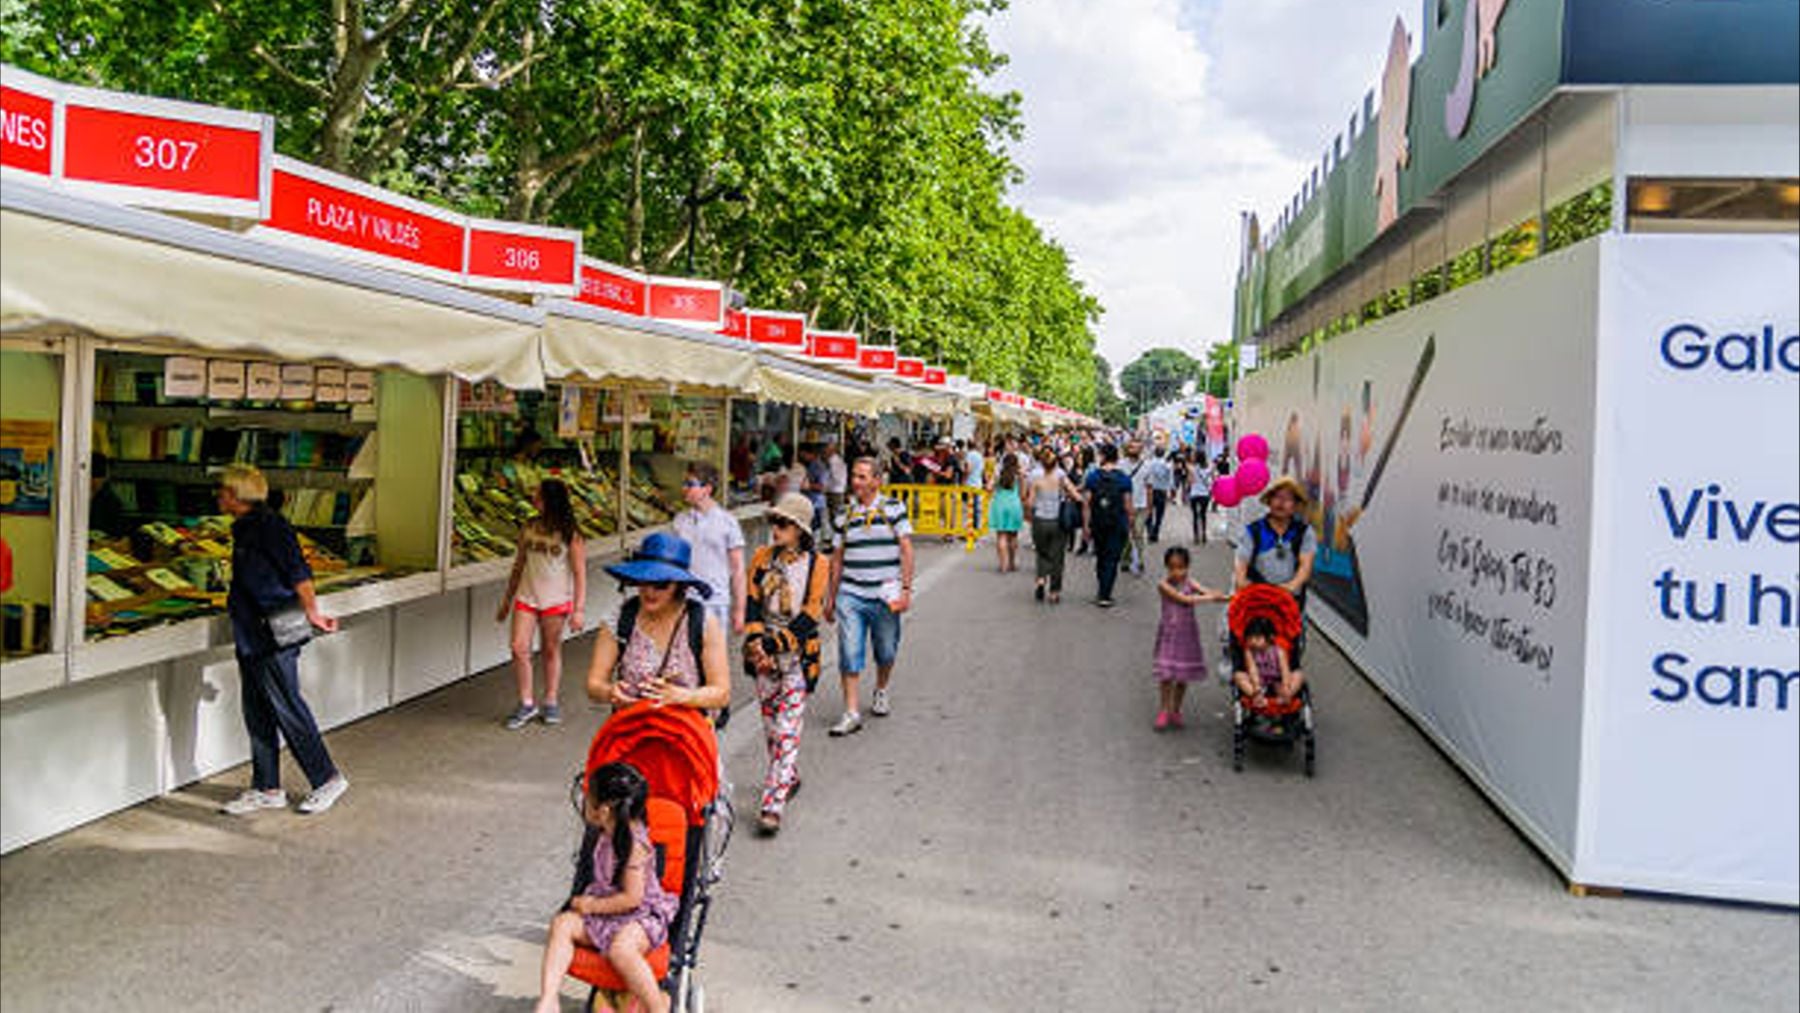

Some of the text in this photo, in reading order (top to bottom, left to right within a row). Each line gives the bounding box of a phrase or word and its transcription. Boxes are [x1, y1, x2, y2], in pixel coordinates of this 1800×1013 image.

[134, 135, 198, 170] 307
[306, 197, 421, 249] PLAZA Y VALDÉS
[504, 247, 541, 271] 306
[1657, 483, 1800, 544] Vive
[1653, 568, 1800, 628] tu h
[1650, 652, 1800, 711] Sam
